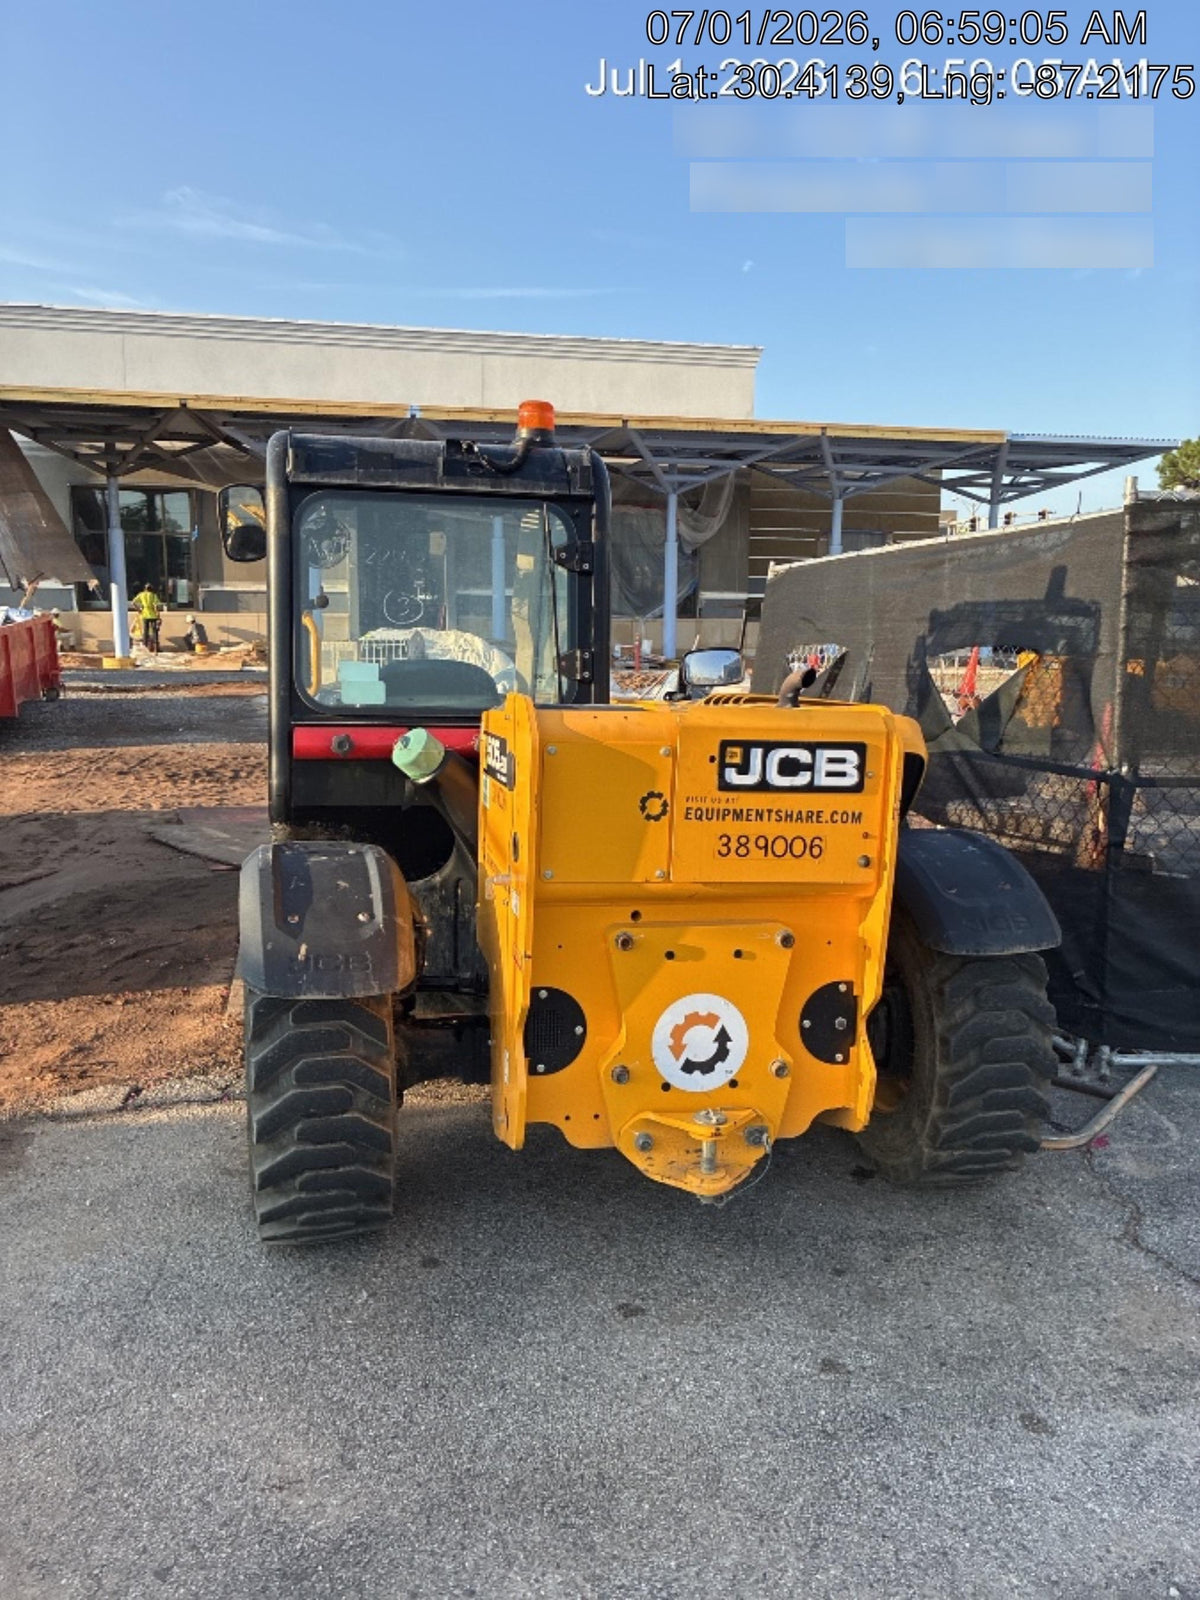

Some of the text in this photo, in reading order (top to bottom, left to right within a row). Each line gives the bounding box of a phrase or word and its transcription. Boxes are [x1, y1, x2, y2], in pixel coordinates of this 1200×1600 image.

[724, 748, 859, 787] JCB
[684, 807, 862, 824] EQUIPMENTSHARE.COM
[717, 834, 823, 859] 389006
